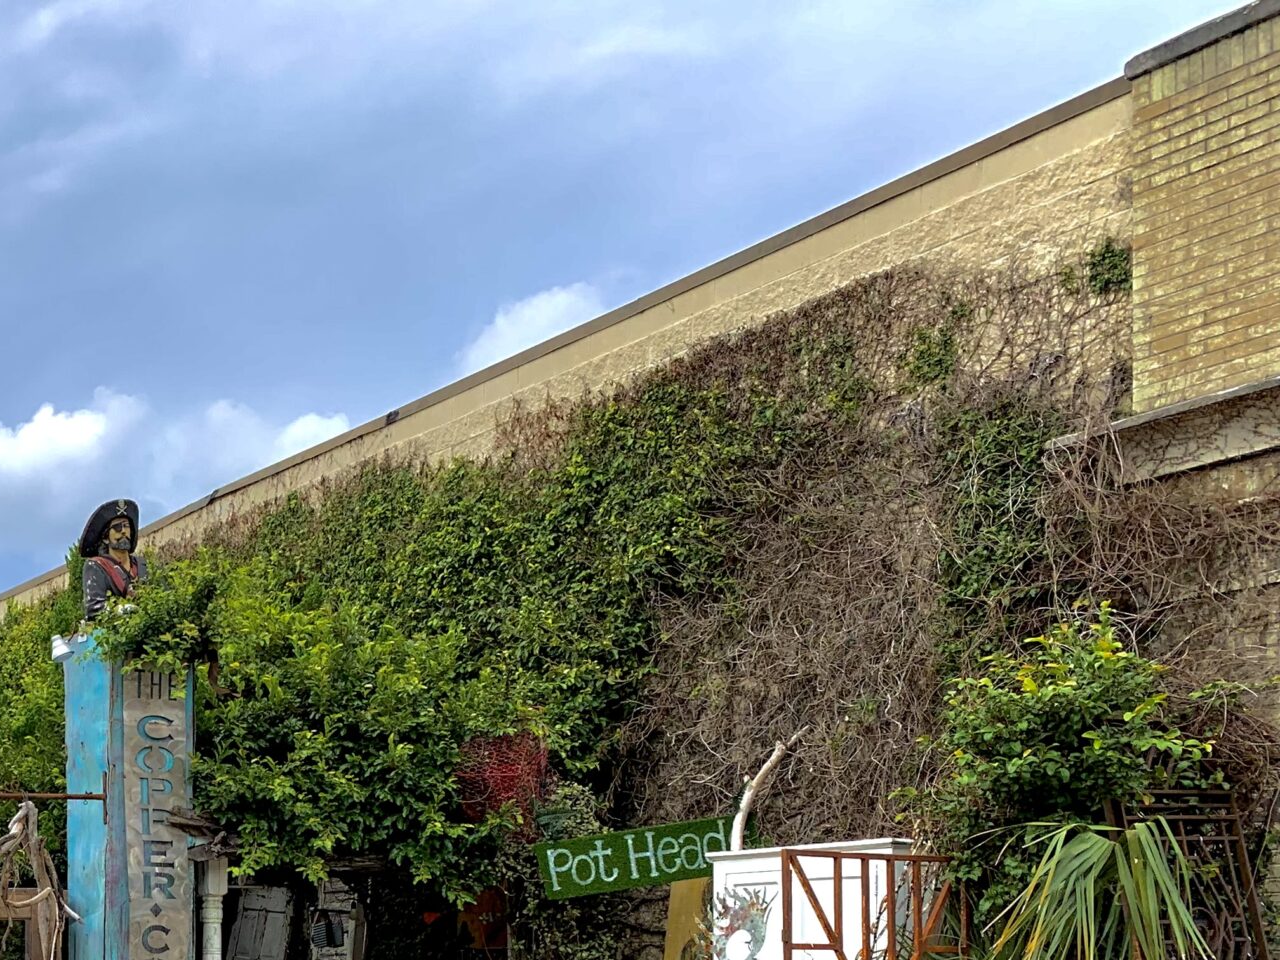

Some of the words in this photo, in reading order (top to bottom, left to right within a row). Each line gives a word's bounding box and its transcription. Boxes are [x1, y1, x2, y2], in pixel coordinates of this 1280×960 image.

[135, 668, 178, 701] THE
[135, 715, 177, 900] COPPER
[546, 839, 619, 891] Pot
[624, 819, 727, 879] Head
